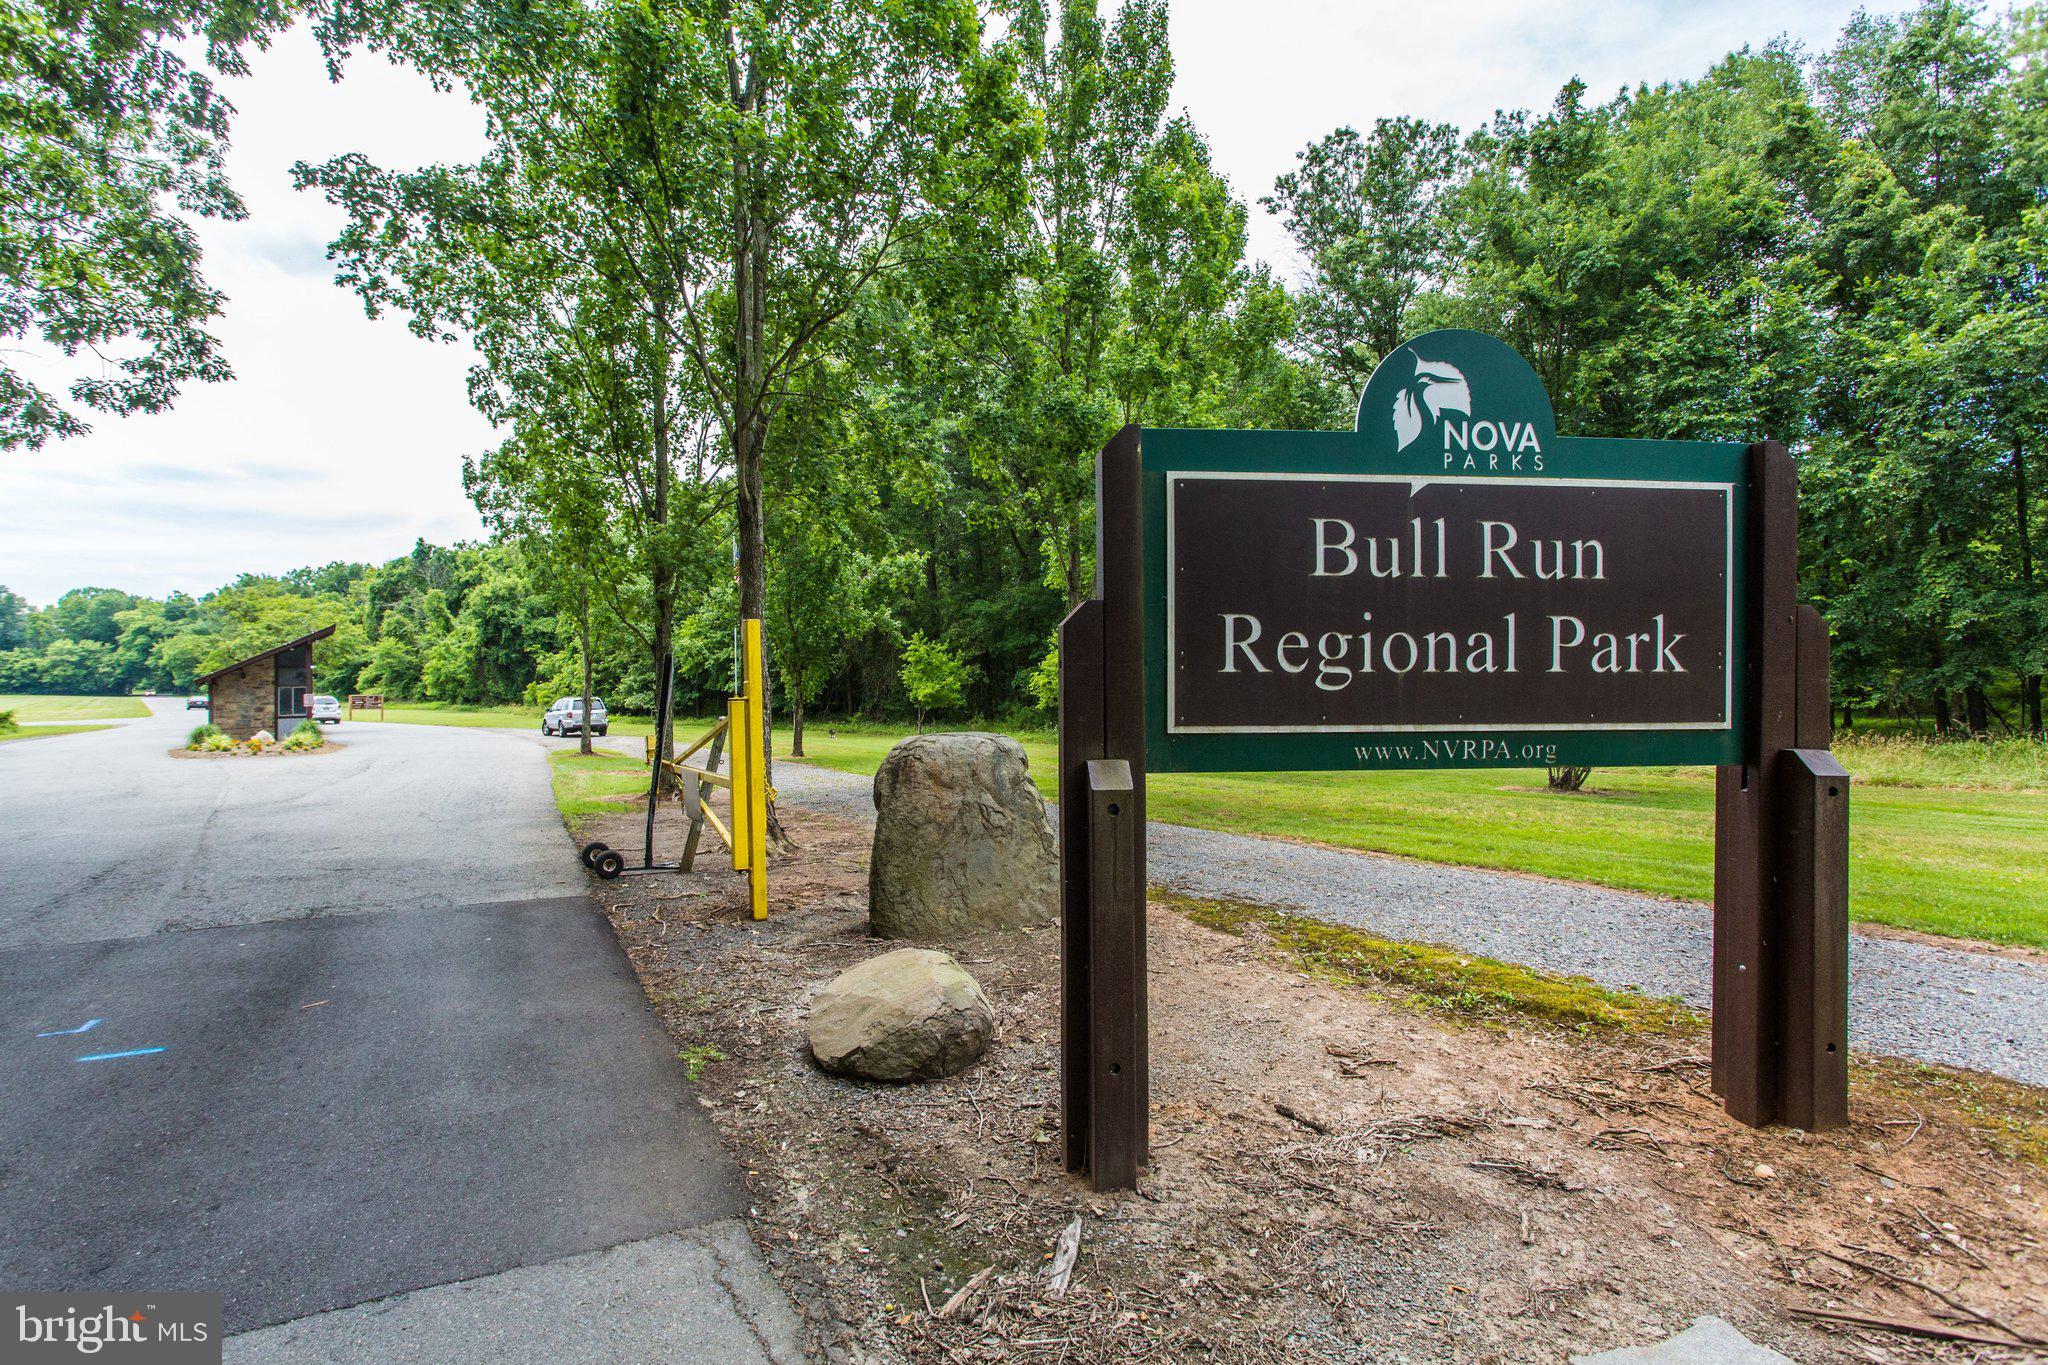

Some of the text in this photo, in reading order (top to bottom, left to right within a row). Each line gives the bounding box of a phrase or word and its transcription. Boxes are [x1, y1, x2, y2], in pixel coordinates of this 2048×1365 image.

[1443, 419, 1541, 452] NOVA
[1443, 453, 1544, 471] PARKS
[1308, 516, 1608, 580] Bull Run
[1217, 611, 1689, 691] Regional Park
[1354, 739, 1558, 764] www.NVRPA.org
